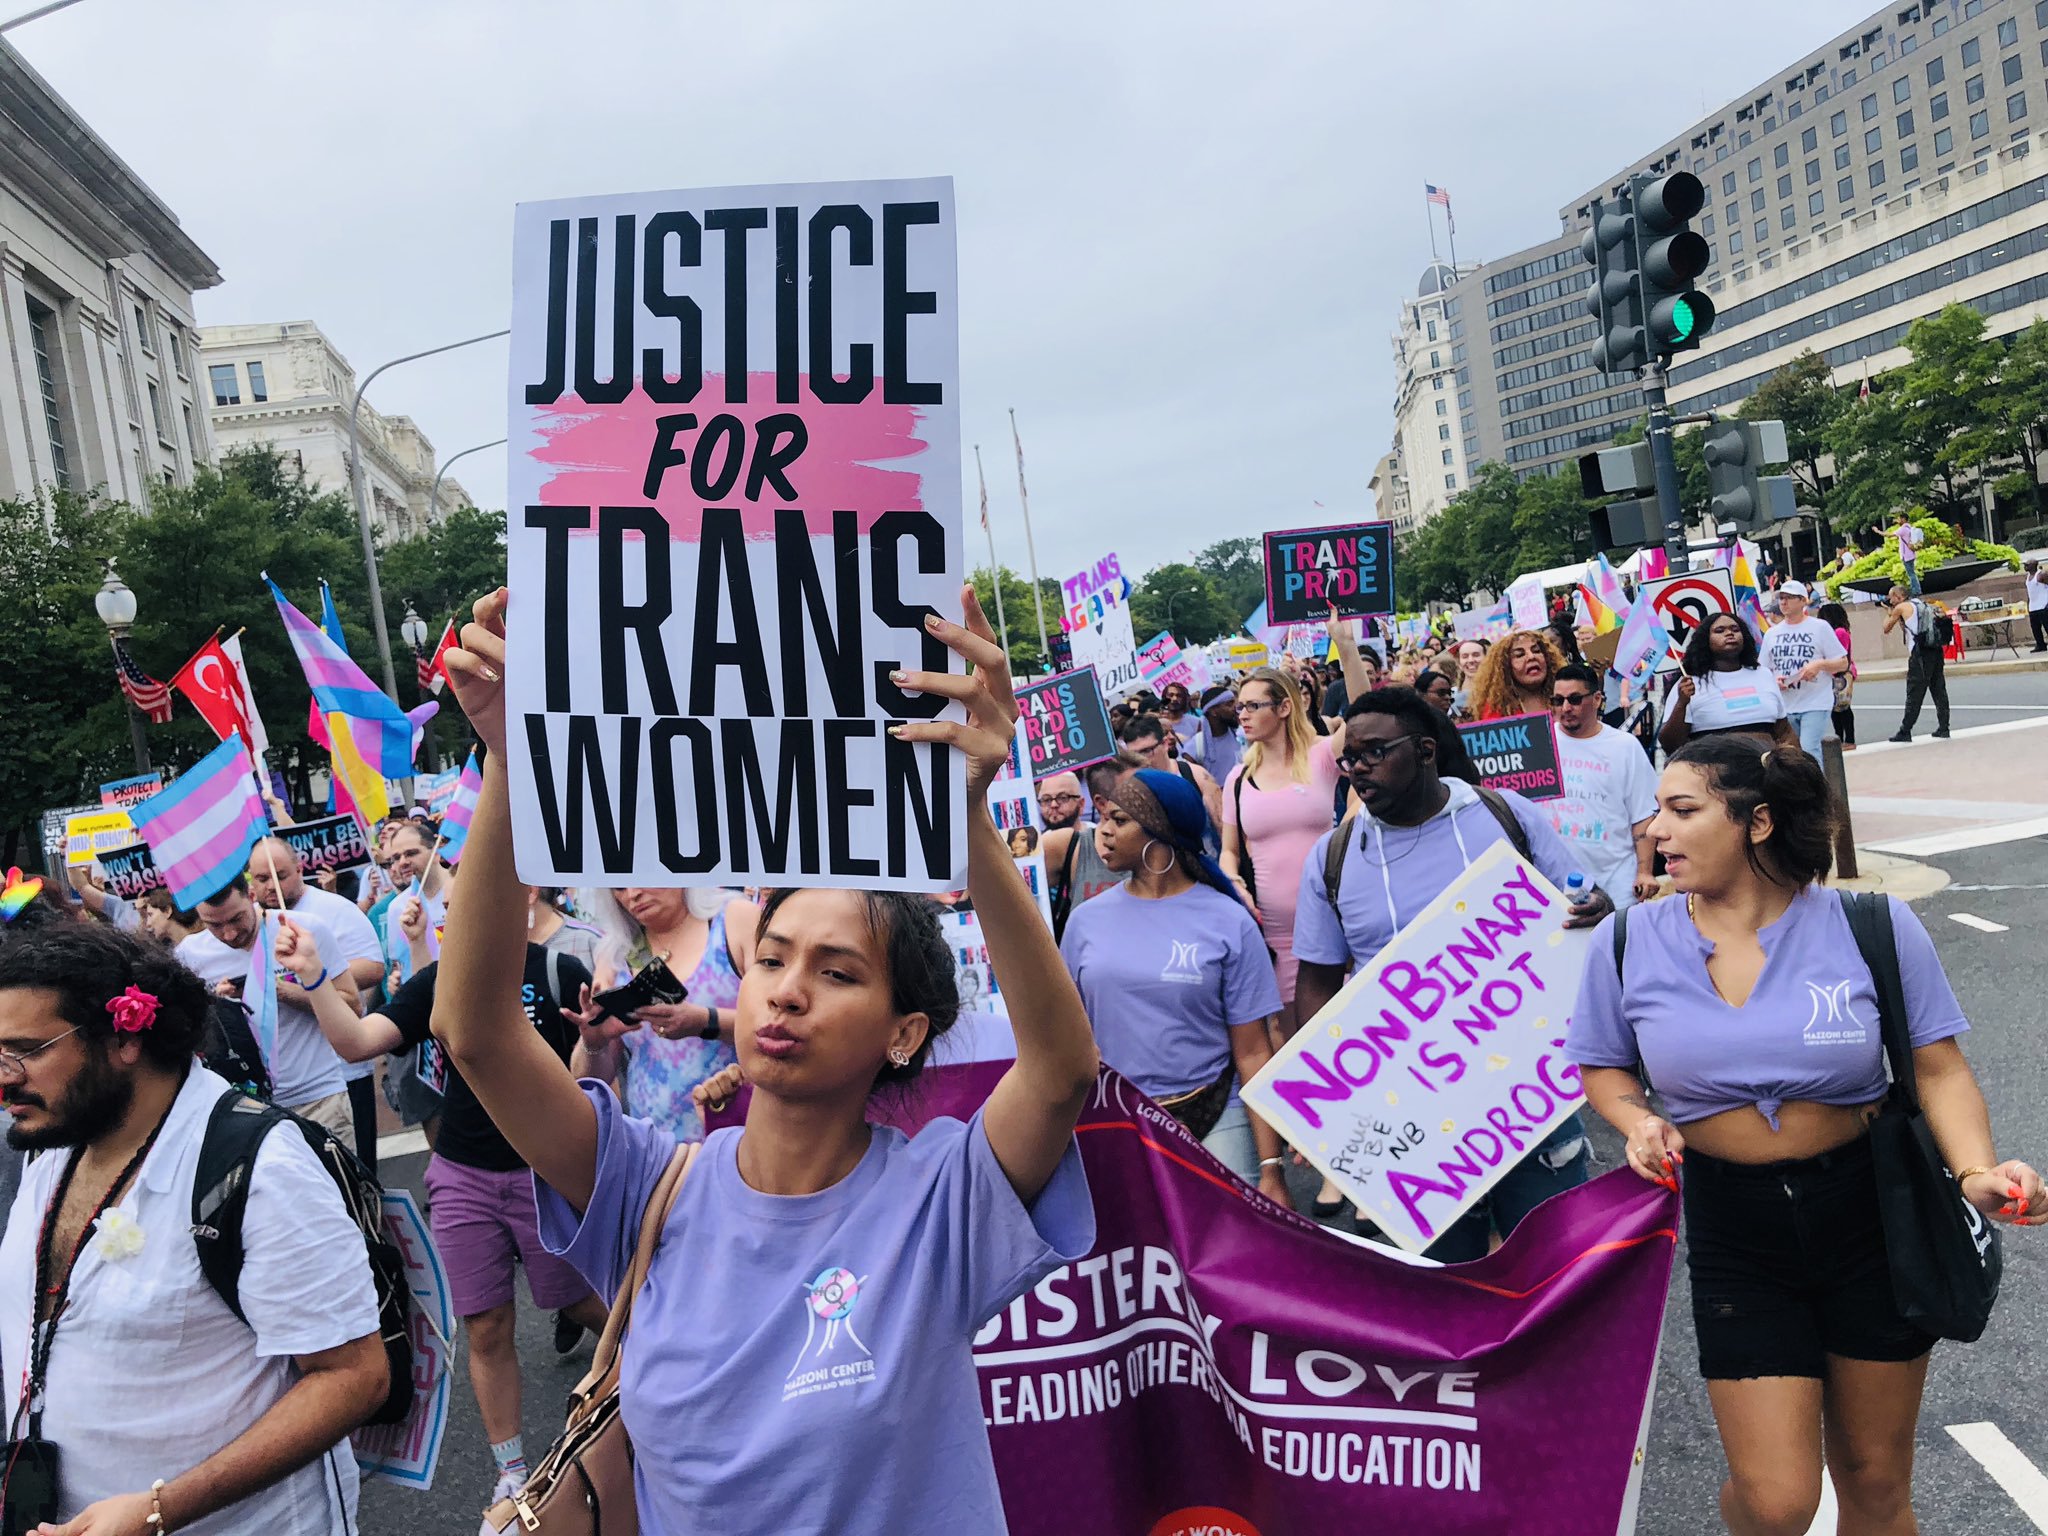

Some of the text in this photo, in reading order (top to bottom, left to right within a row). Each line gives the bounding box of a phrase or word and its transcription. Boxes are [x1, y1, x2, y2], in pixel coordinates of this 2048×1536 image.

[525, 201, 943, 405] JUSTICE
[642, 412, 809, 502] FOR
[1278, 535, 1378, 572] TRANS
[1063, 552, 1121, 603] TRANS
[1284, 565, 1378, 600] PRIDE
[524, 505, 949, 719] TRANS
[1776, 632, 1813, 643] TRANS
[1016, 683, 1074, 717] RANS
[1025, 704, 1080, 740] RIDE
[1461, 724, 1531, 757] THANK
[1473, 752, 1524, 776] YOUR
[1561, 757, 1611, 773] TIONAL
[112, 781, 154, 799] PROTECT
[524, 713, 952, 880] WOMEN
[287, 821, 359, 851] ON'T BE
[103, 852, 145, 877] WON'T
[297, 839, 365, 871] RASED
[1407, 951, 1545, 1093] IS NOT
[1386, 1035, 1584, 1239] ANDROG
[1390, 1121, 1426, 1160] NB
[784, 1360, 875, 1392] MAZZONI CENTER
[1250, 1331, 1481, 1408] LOVE
[984, 1360, 1121, 1426] EADING
[1127, 1341, 1221, 1403] OTHERS
[1261, 1427, 1482, 1492] EDUCATION
